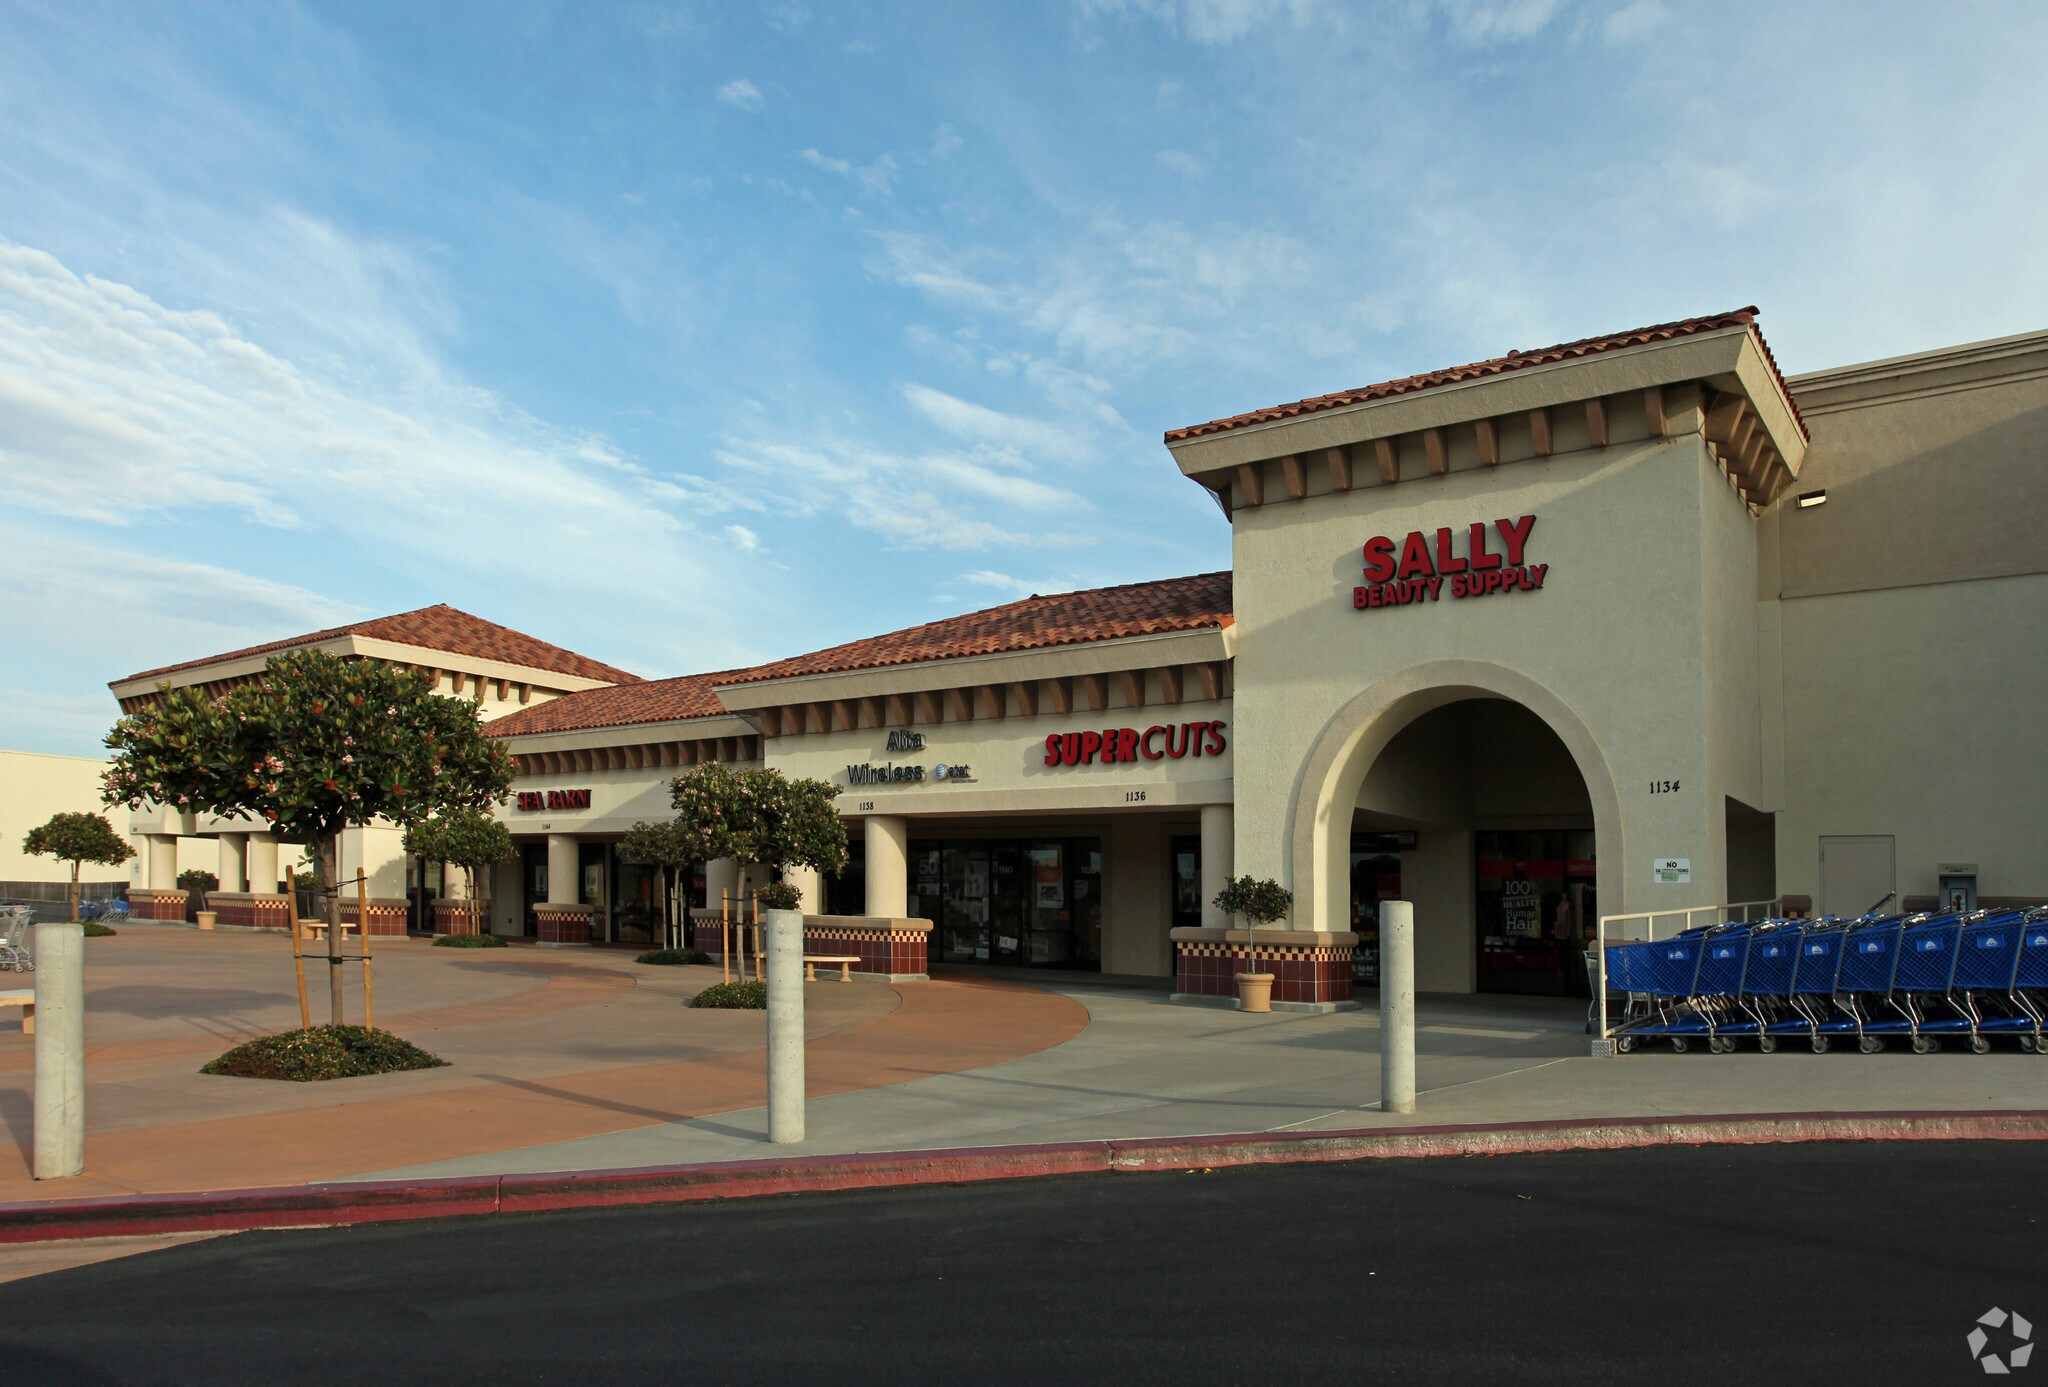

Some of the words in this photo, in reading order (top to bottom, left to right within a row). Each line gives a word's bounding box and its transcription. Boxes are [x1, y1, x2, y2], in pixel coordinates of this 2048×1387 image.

[1362, 514, 1537, 583] SALLY
[1353, 576, 1443, 609] BEAUTY
[1451, 563, 1549, 598] SUPPLY
[1044, 719, 1227, 767] SUPERCUTS
[847, 762, 927, 784] Wireless
[1650, 780, 1680, 794] 1134
[517, 791, 546, 811] SEA
[547, 788, 592, 809] BARN
[1126, 791, 1146, 801] 1136
[859, 801, 874, 811] 1138
[1503, 899, 1539, 908] QUALITY
[1506, 909, 1537, 917] Human
[1506, 916, 1537, 930] Hair
